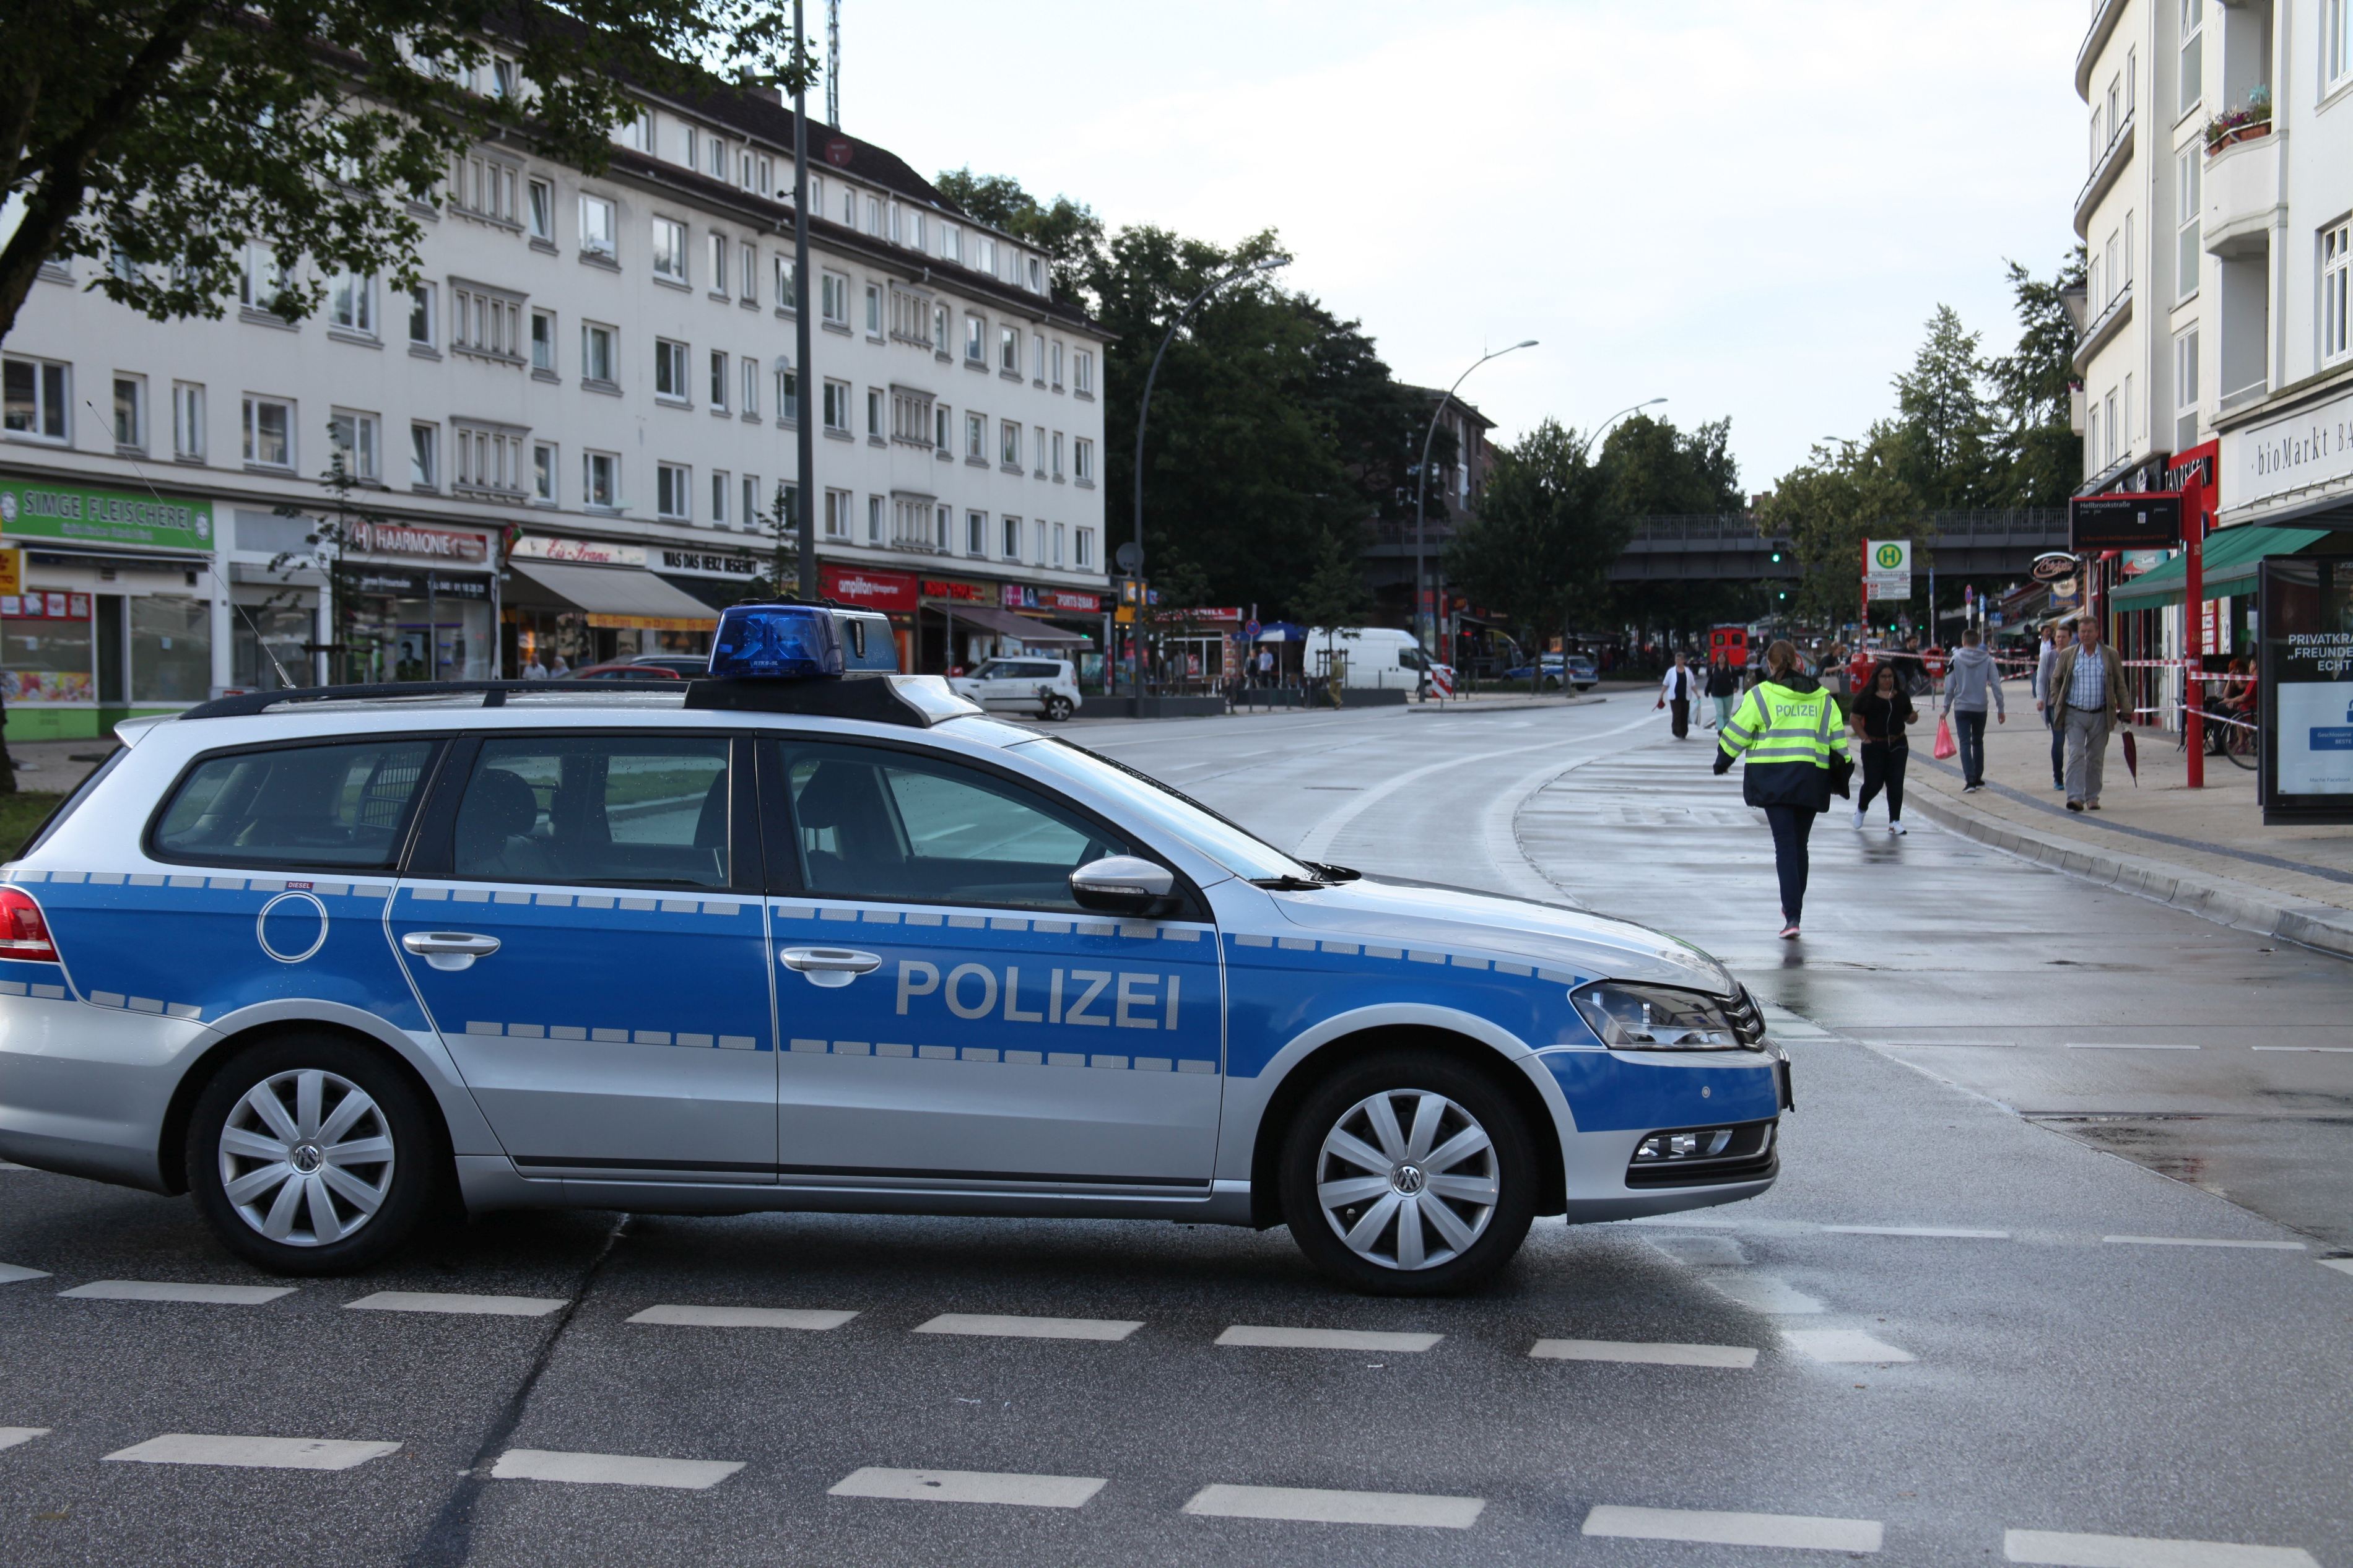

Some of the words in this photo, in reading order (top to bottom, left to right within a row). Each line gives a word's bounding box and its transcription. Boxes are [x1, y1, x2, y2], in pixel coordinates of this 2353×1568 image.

[2258, 426, 2327, 476] bioMarkt
[24, 490, 82, 519] SIMGE
[87, 496, 191, 530] FLEISCHEREI
[2080, 501, 2131, 509] Hellbrookstraße
[376, 528, 450, 555] HAARMONIE
[663, 551, 682, 568] WAS
[684, 553, 700, 569] DAS
[702, 555, 723, 571] HERZ
[838, 576, 872, 599] amplifon
[2318, 660, 2352, 671] ECHT
[1776, 704, 1817, 717] POLIZEI
[895, 960, 1180, 1030] POLIZEI
